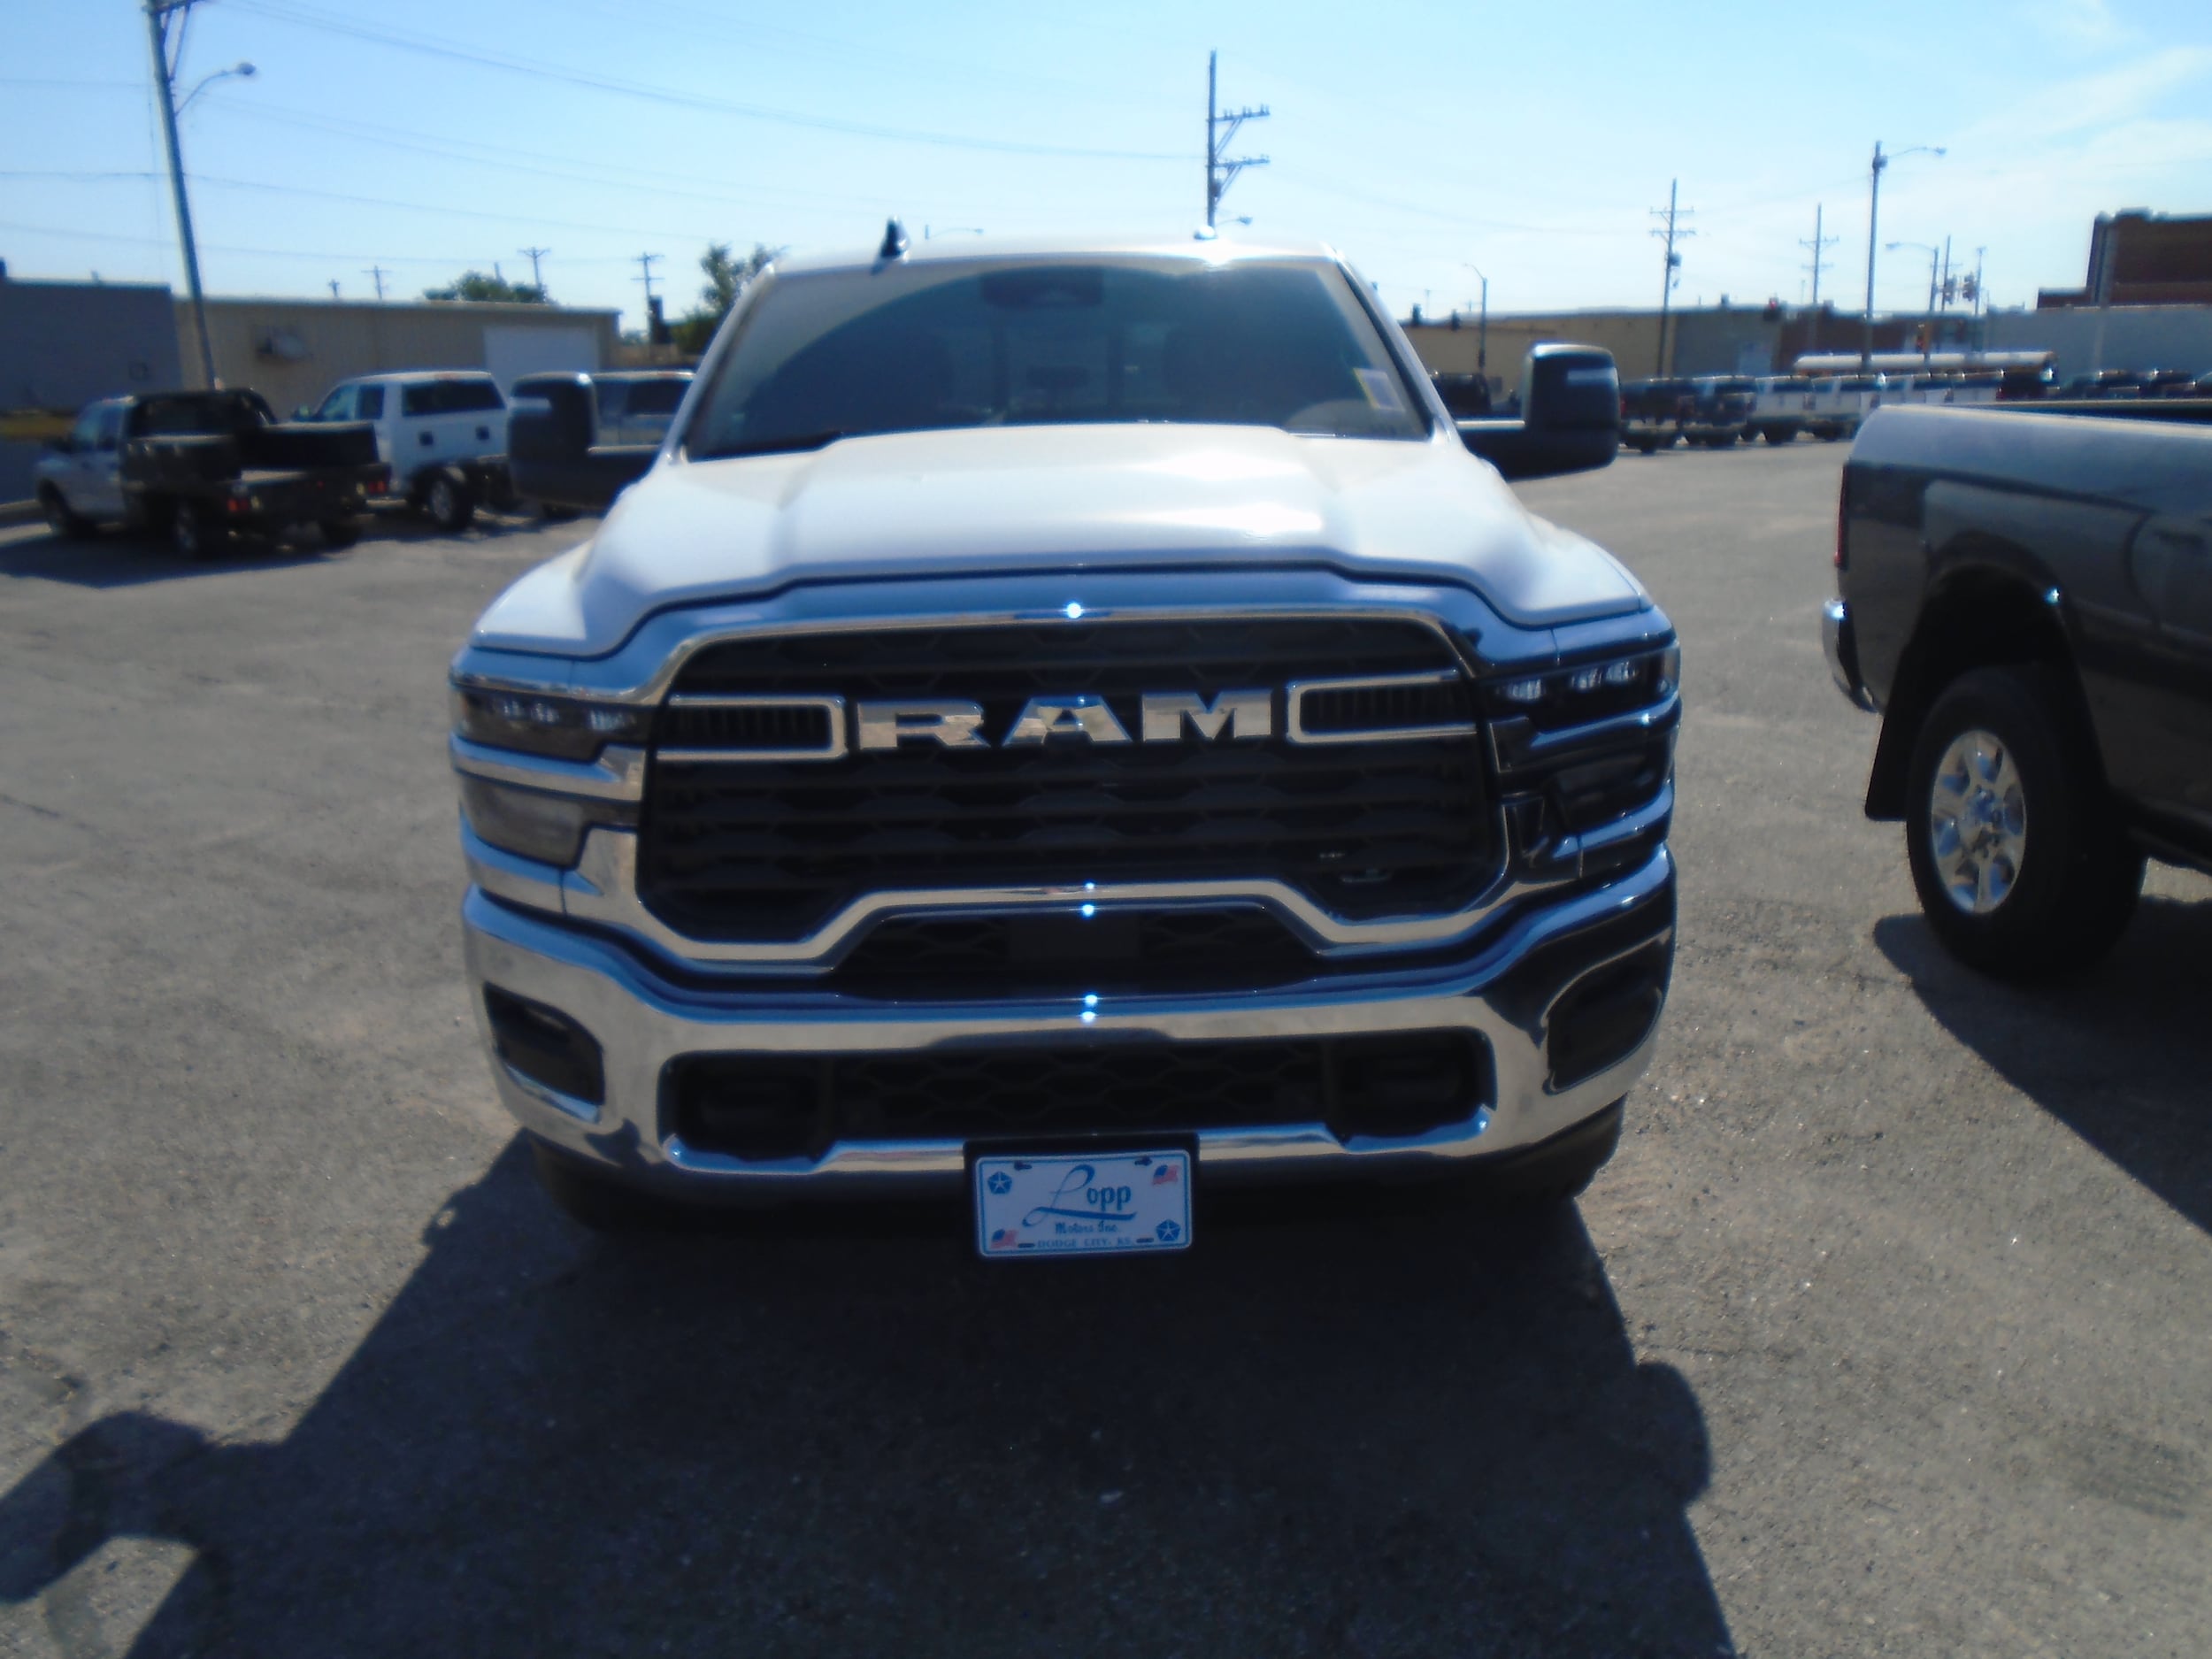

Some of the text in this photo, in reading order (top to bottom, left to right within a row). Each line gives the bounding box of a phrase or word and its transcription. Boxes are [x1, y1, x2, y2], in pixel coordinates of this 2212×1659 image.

[857, 690, 1272, 749] RAM
[1055, 1222, 1094, 1234] Motors
[1037, 1239, 1077, 1248] DODGE
